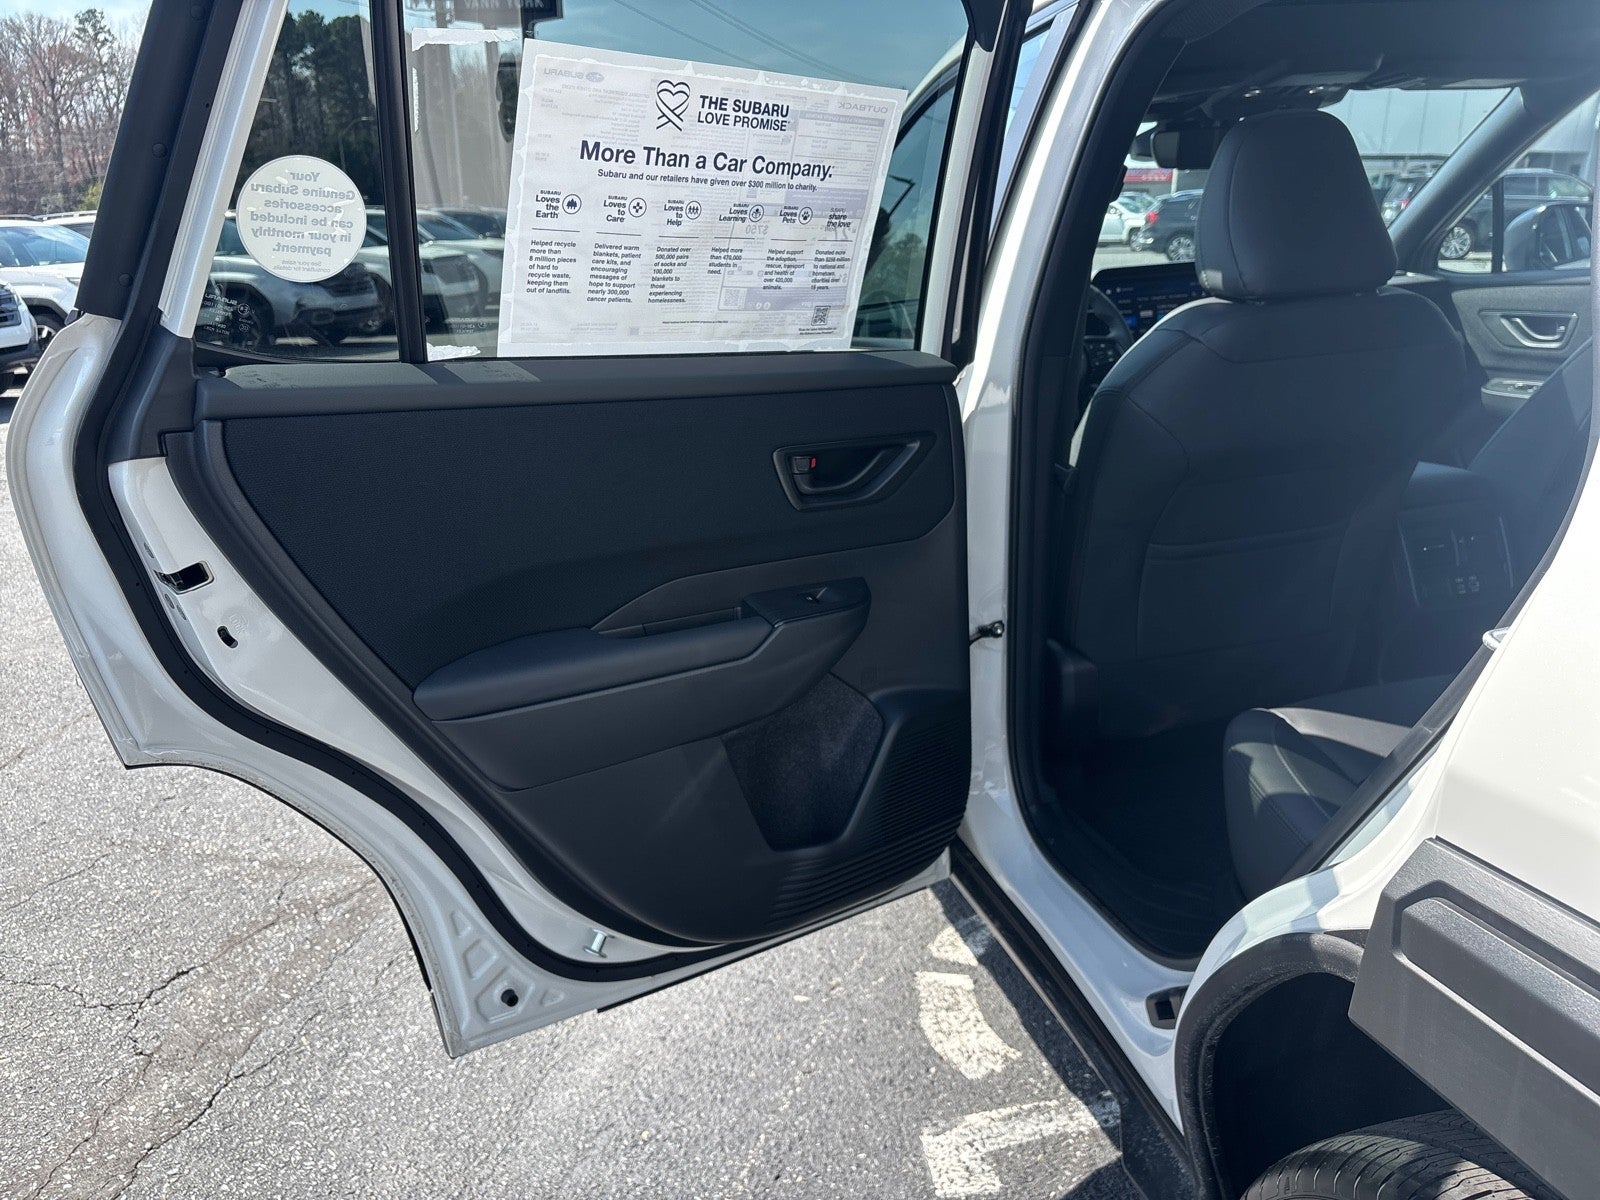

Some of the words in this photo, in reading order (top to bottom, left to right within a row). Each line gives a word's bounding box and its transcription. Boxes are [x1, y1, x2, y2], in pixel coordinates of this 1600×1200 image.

[700, 95, 728, 111] THE
[732, 99, 789, 118] SUBARU
[698, 111, 730, 126] LOVE
[733, 115, 787, 131] PROMISE
[580, 140, 636, 164] More
[643, 146, 689, 168] Than
[695, 155, 706, 169] a
[713, 152, 747, 172] Car
[752, 156, 832, 181] Company.
[598, 169, 626, 178] Subaru
[660, 174, 688, 182] retailers
[691, 176, 708, 184] have
[710, 178, 729, 186] given
[748, 180, 763, 188] $300
[795, 183, 817, 192] charity.
[536, 195, 560, 203] Loves
[546, 203, 559, 211] the
[604, 200, 626, 208] Loves
[536, 210, 559, 219] Earth
[667, 219, 682, 227] Help
[719, 215, 746, 223] Learning
[591, 266, 627, 274] encouraging
